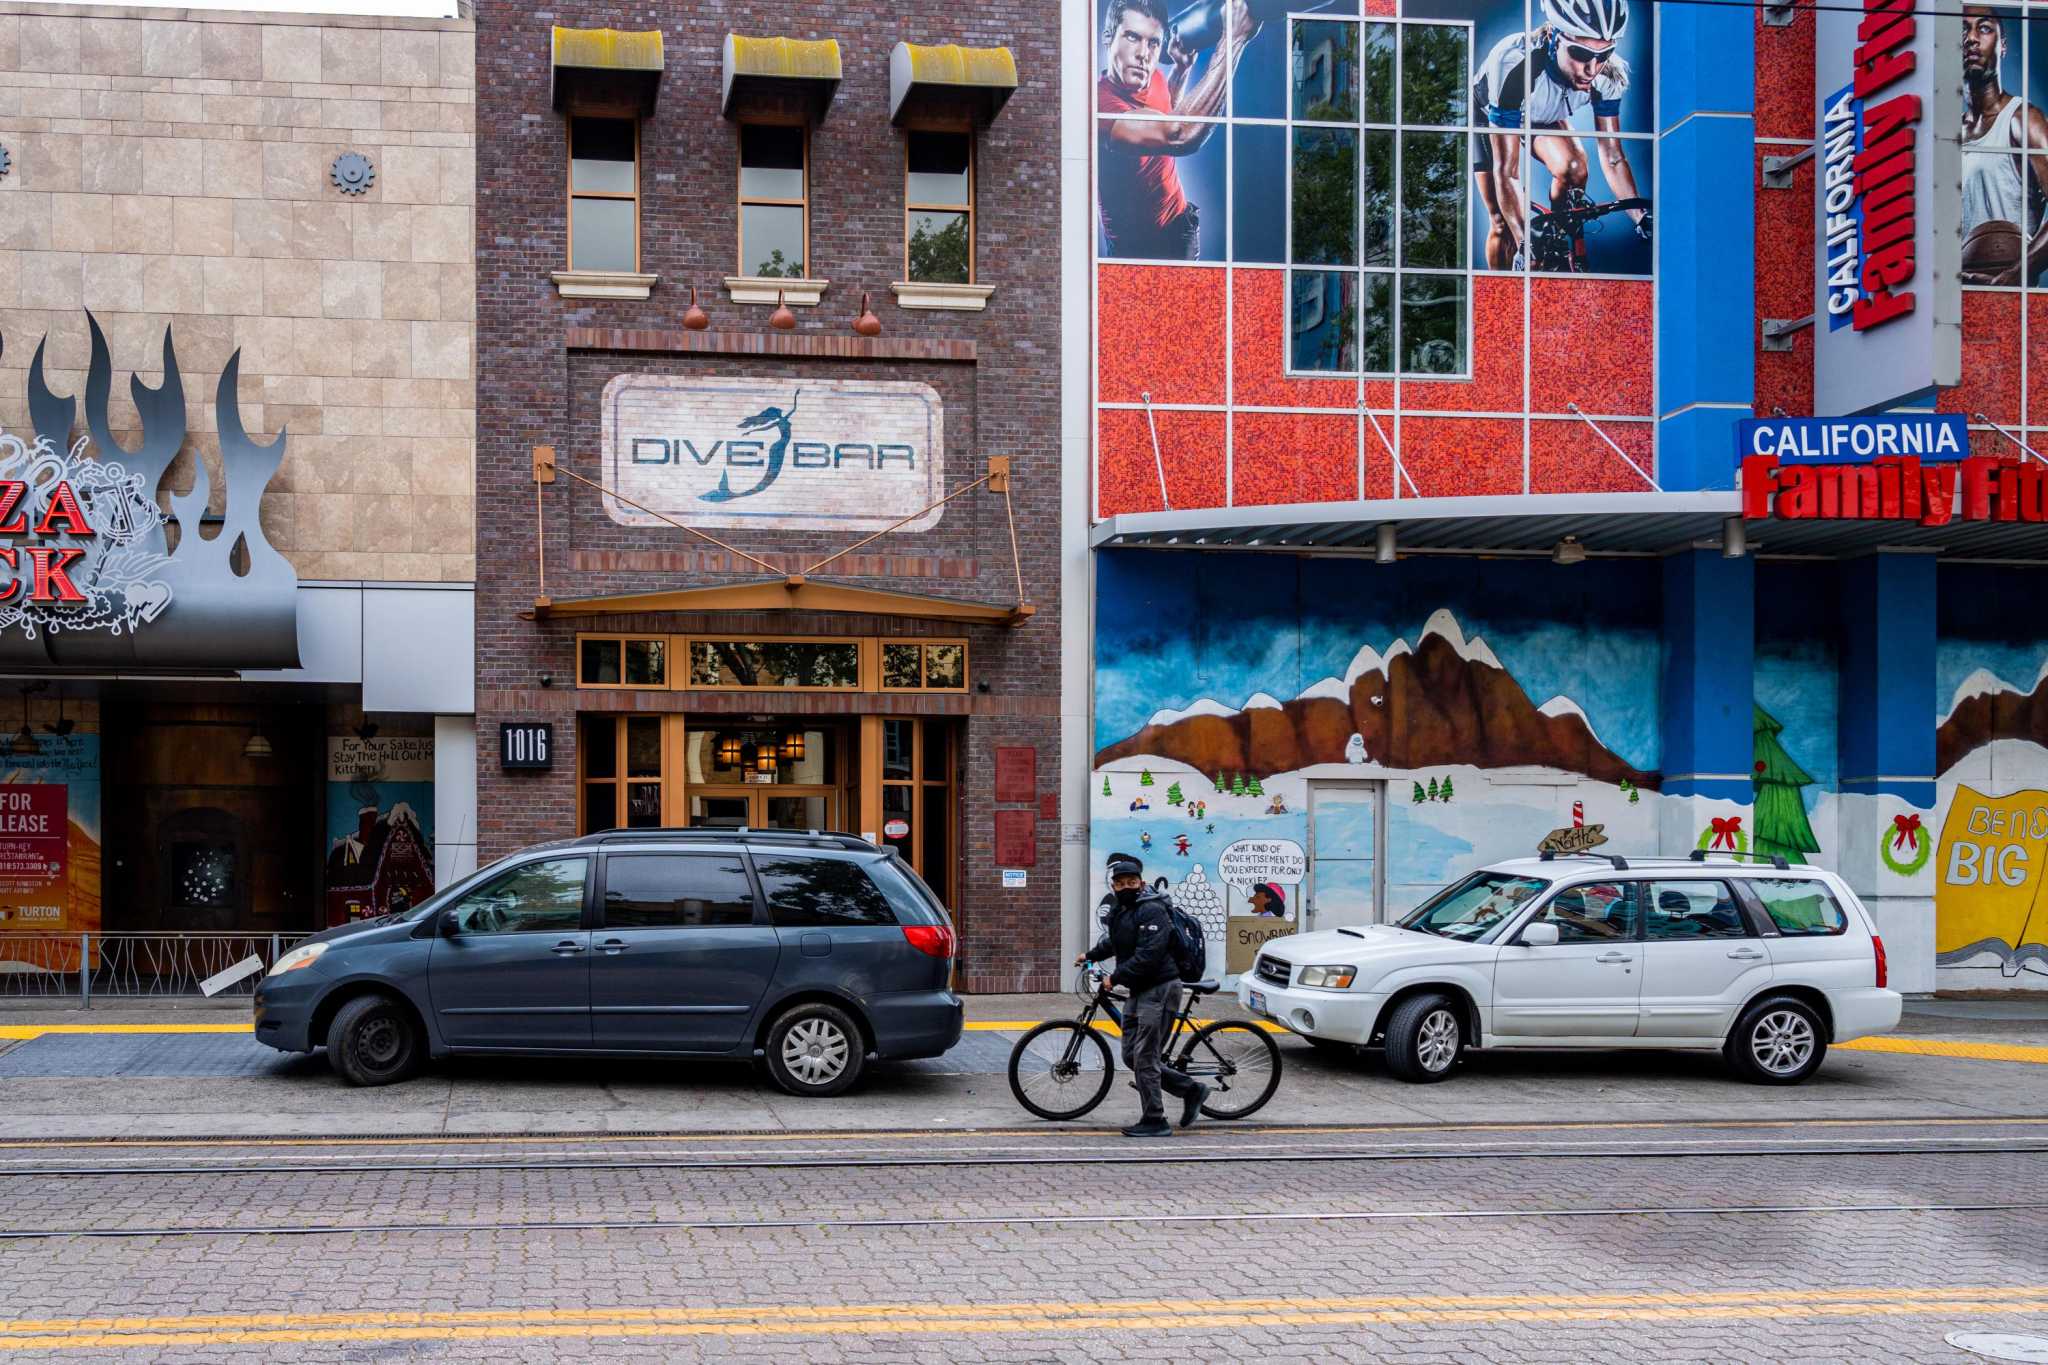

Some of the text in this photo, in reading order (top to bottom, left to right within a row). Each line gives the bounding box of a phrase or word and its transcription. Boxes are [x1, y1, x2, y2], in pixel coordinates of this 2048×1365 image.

[1854, 0, 1917, 99] Fit
[1824, 91, 1860, 315] CALIFORNIA
[1853, 94, 1922, 332] Family
[1753, 422, 1960, 456] CALIFORNIA
[631, 437, 915, 471] DIVE BAR
[1742, 454, 2048, 527] Family Fit
[333, 752, 355, 763] Stay
[357, 751, 377, 761] The
[342, 739, 360, 751] For
[505, 728, 546, 761] 1016
[0, 792, 32, 811] FOR
[0, 814, 49, 833] LEASE
[1223, 854, 1304, 865] ADVERTISEMENT DO
[1232, 844, 1281, 854] WHAT KIND OF
[1222, 865, 1238, 874] YOU
[1239, 866, 1268, 875] EXPECT
[1945, 841, 2029, 887] BIG
[18, 905, 61, 917] TURTON
